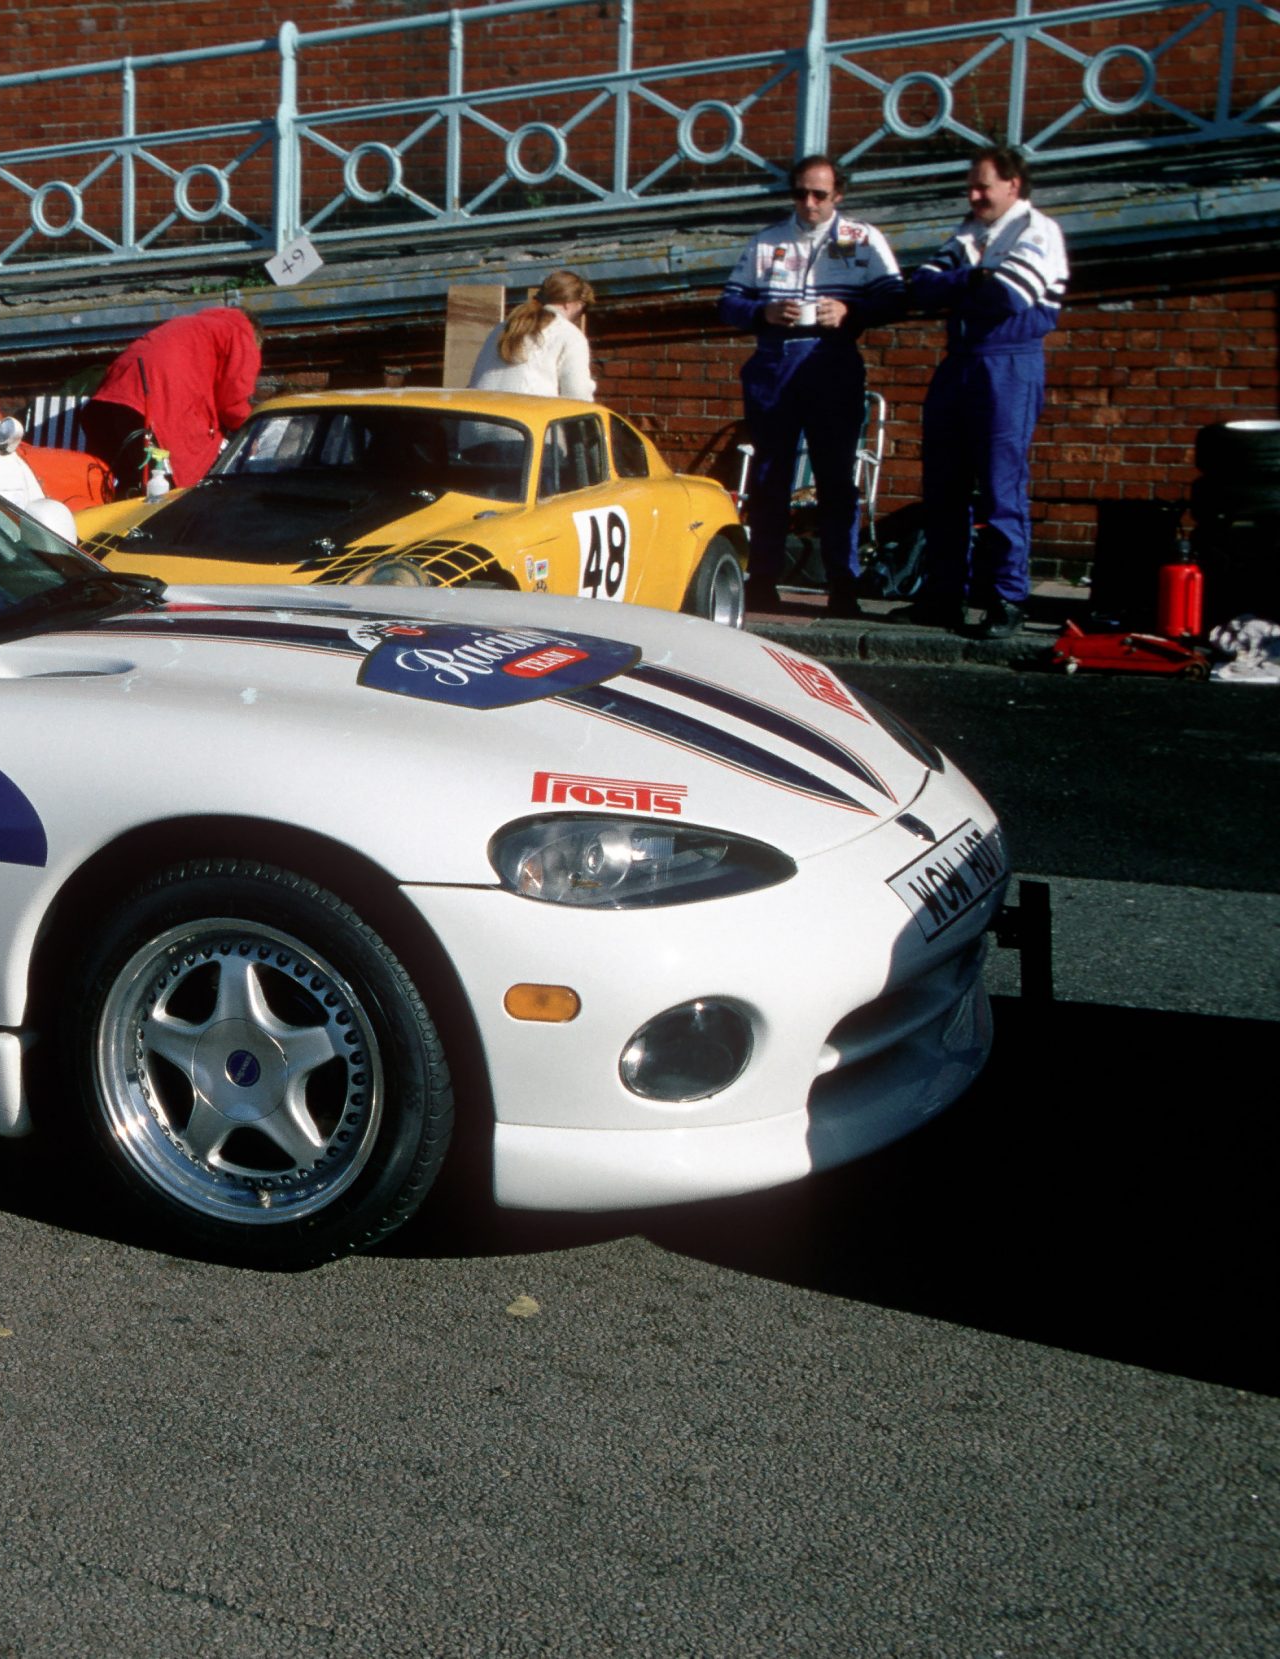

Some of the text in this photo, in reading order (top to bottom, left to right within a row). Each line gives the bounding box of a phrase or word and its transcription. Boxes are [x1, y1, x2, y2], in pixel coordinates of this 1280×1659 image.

[582, 511, 627, 599] 48
[395, 631, 578, 686] Racing
[515, 649, 575, 673] TEAM
[531, 771, 688, 815] Frosts
[907, 856, 974, 927] WOW
